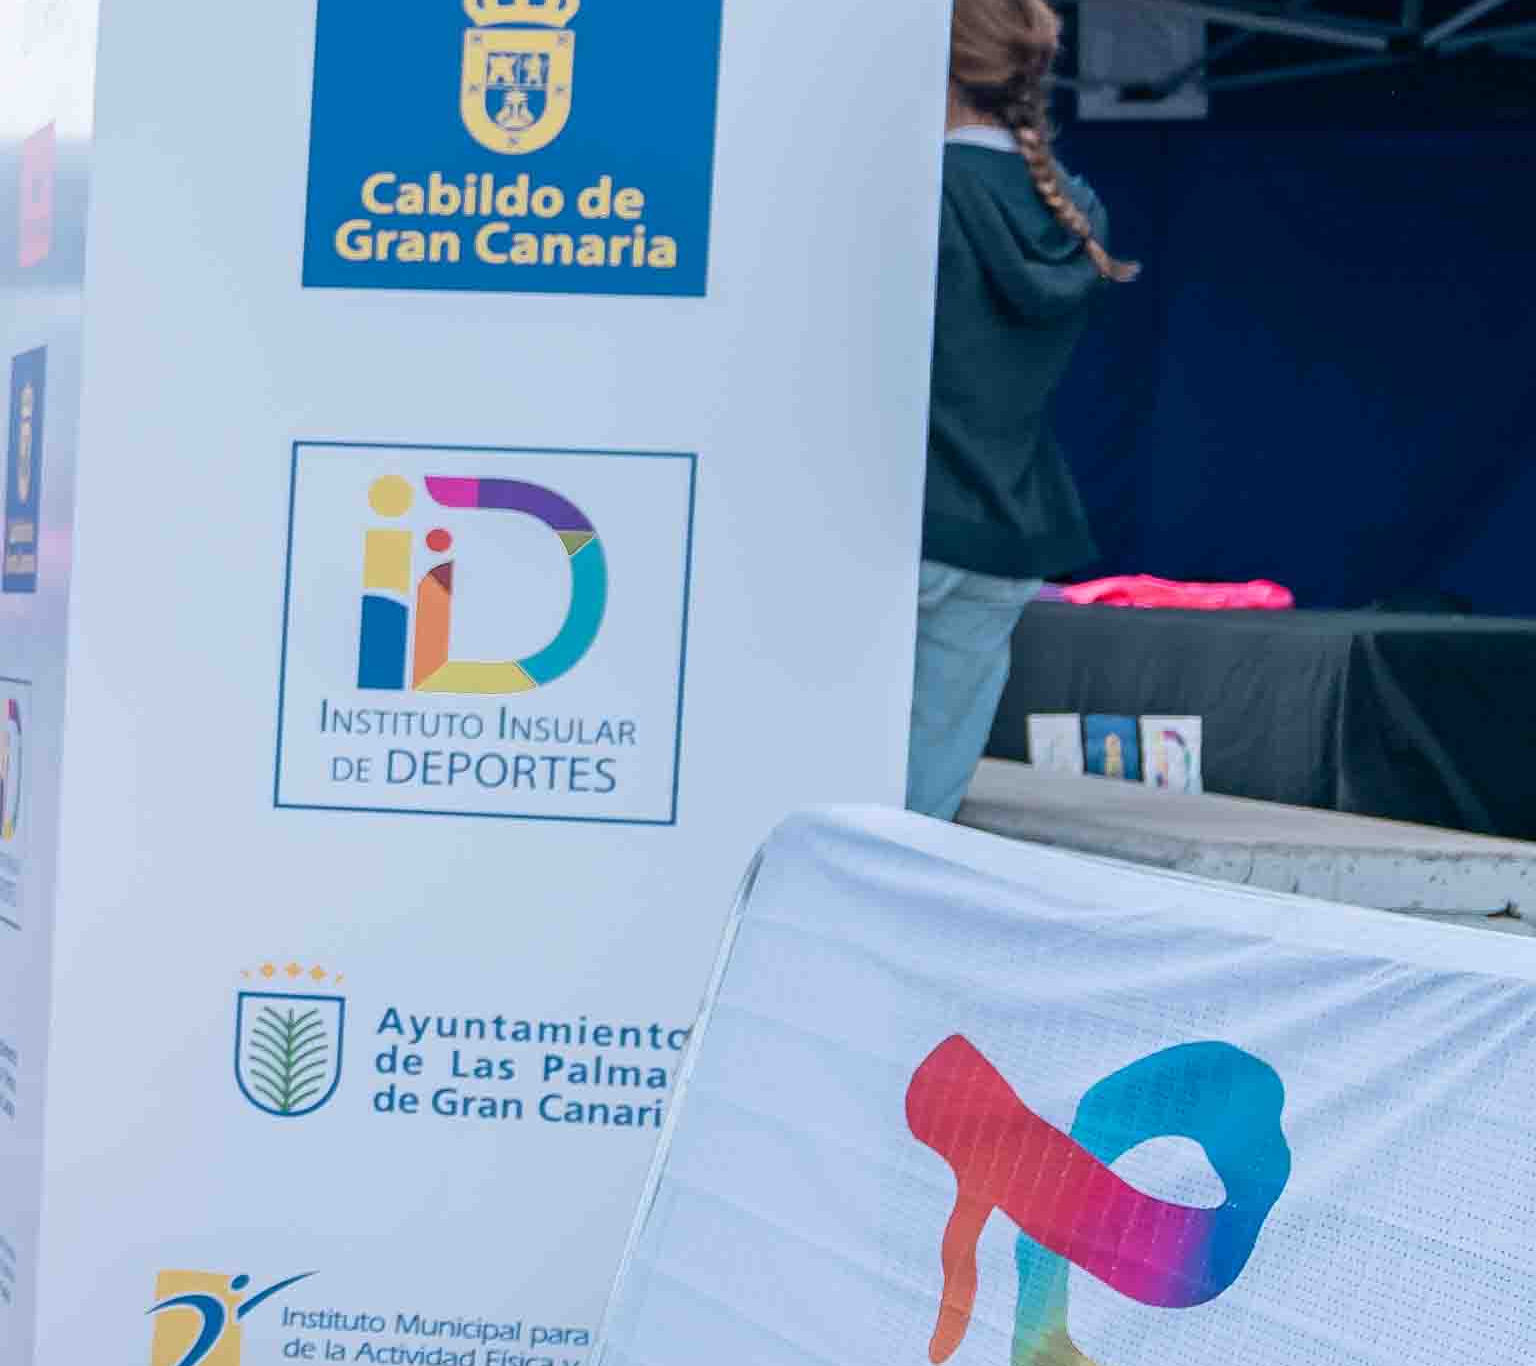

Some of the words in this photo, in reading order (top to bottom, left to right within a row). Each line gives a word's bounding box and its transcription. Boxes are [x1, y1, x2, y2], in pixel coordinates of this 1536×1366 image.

[361, 172, 566, 218] Cabildo
[578, 176, 645, 220] de
[334, 220, 462, 263] Gran
[474, 220, 679, 270] Canaria
[318, 700, 483, 741] INSTITUTO
[497, 705, 638, 748] INSULAR
[330, 755, 370, 783] DE
[386, 750, 616, 794] DEPORTES
[376, 1006, 691, 1052] Ayuntamiento
[374, 1047, 425, 1077] de
[451, 1049, 516, 1081] Las
[542, 1054, 674, 1090] Palma
[372, 1085, 420, 1116] de
[431, 1088, 525, 1122] Gran
[537, 1093, 664, 1130] Canari
[281, 1306, 388, 1336] Instituto
[394, 1313, 524, 1348] Municipal
[530, 1324, 590, 1352] para
[282, 1335, 316, 1361] de
[323, 1337, 348, 1364] la
